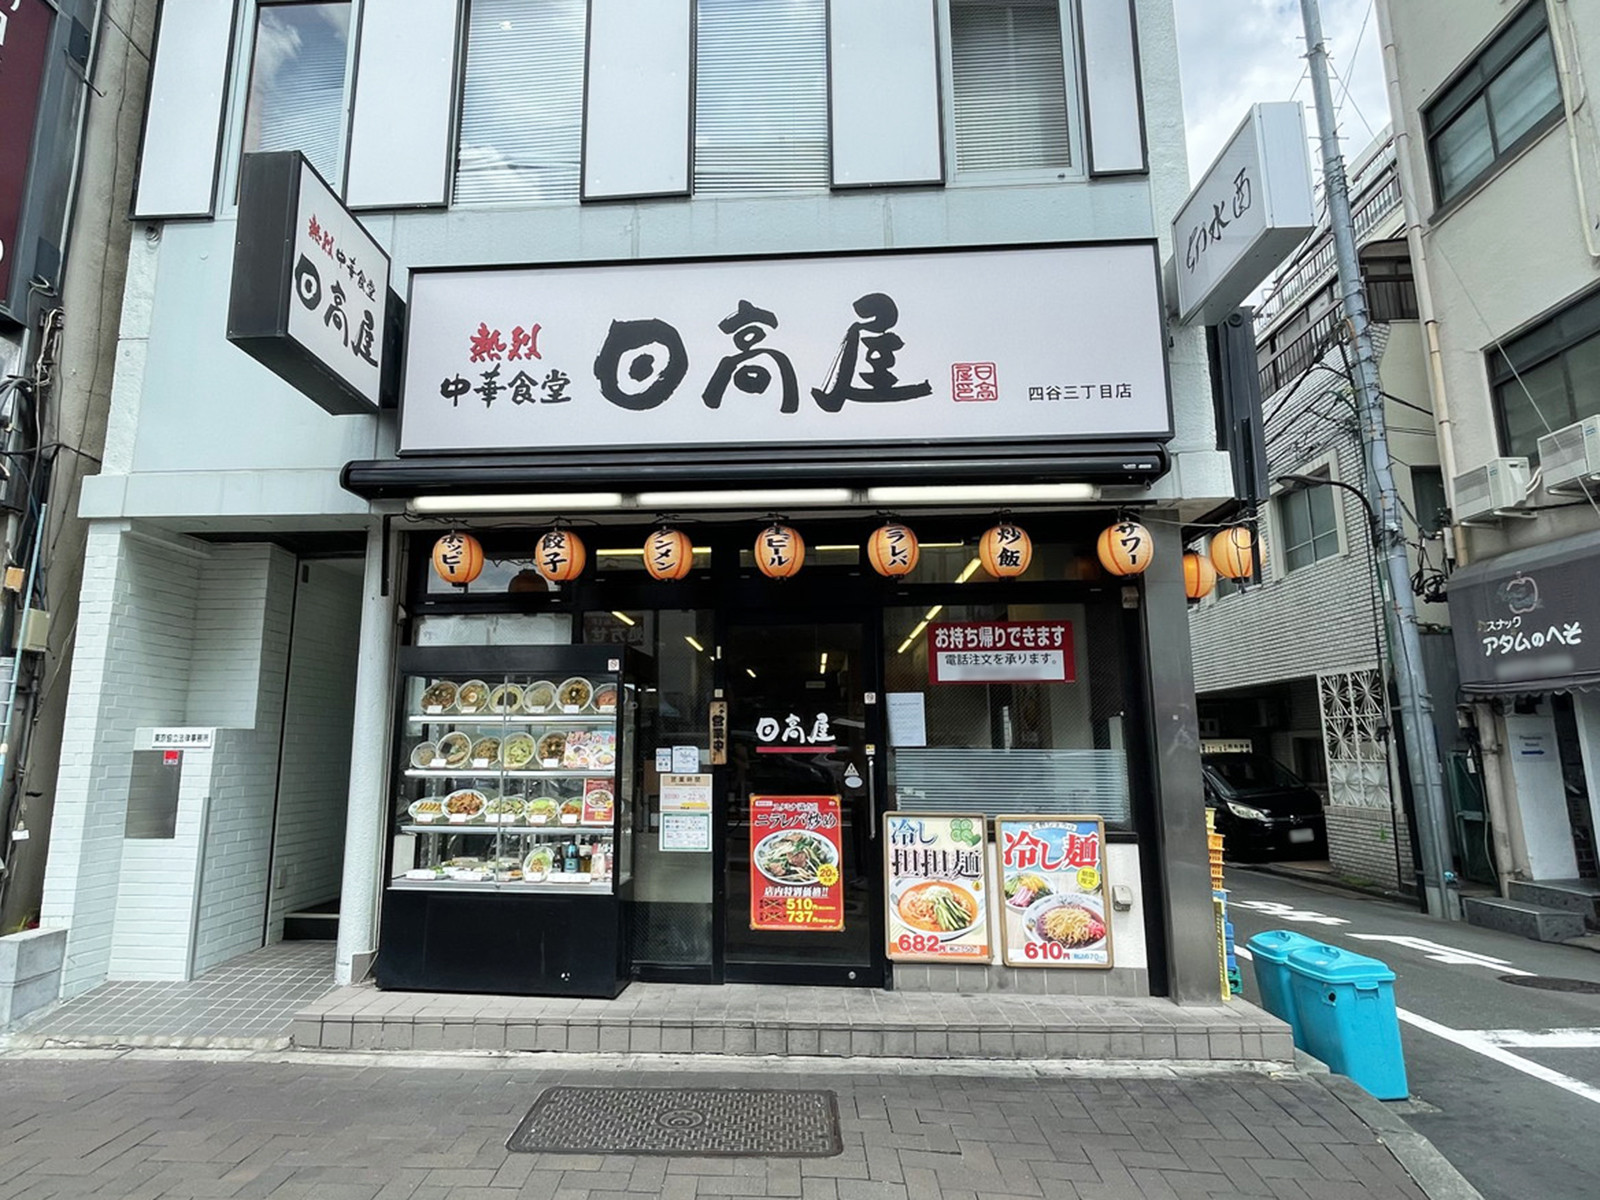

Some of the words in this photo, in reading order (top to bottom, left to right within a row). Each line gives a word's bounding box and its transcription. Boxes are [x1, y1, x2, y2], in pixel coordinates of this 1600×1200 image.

[294, 252, 379, 369] 日高屋
[469, 321, 543, 364] 熱烈
[593, 292, 934, 414] 日高屋
[439, 362, 573, 409] 中華食堂
[1028, 383, 1133, 401] 四谷三丁目店
[440, 533, 465, 575] ホッピー
[542, 531, 568, 574] 餃子
[996, 526, 1022, 568] 炒飯
[1114, 522, 1142, 566] サワー
[934, 625, 1066, 649] お持ち帰りできます
[1486, 615, 1522, 632] スナック
[944, 652, 1058, 667] 電話注文を承ります。
[755, 711, 837, 744] 日高屋
[890, 818, 938, 846] 冷し
[1003, 830, 1099, 870] 冷し麺
[898, 934, 946, 952] 682円
[1024, 942, 1071, 961] 610円
